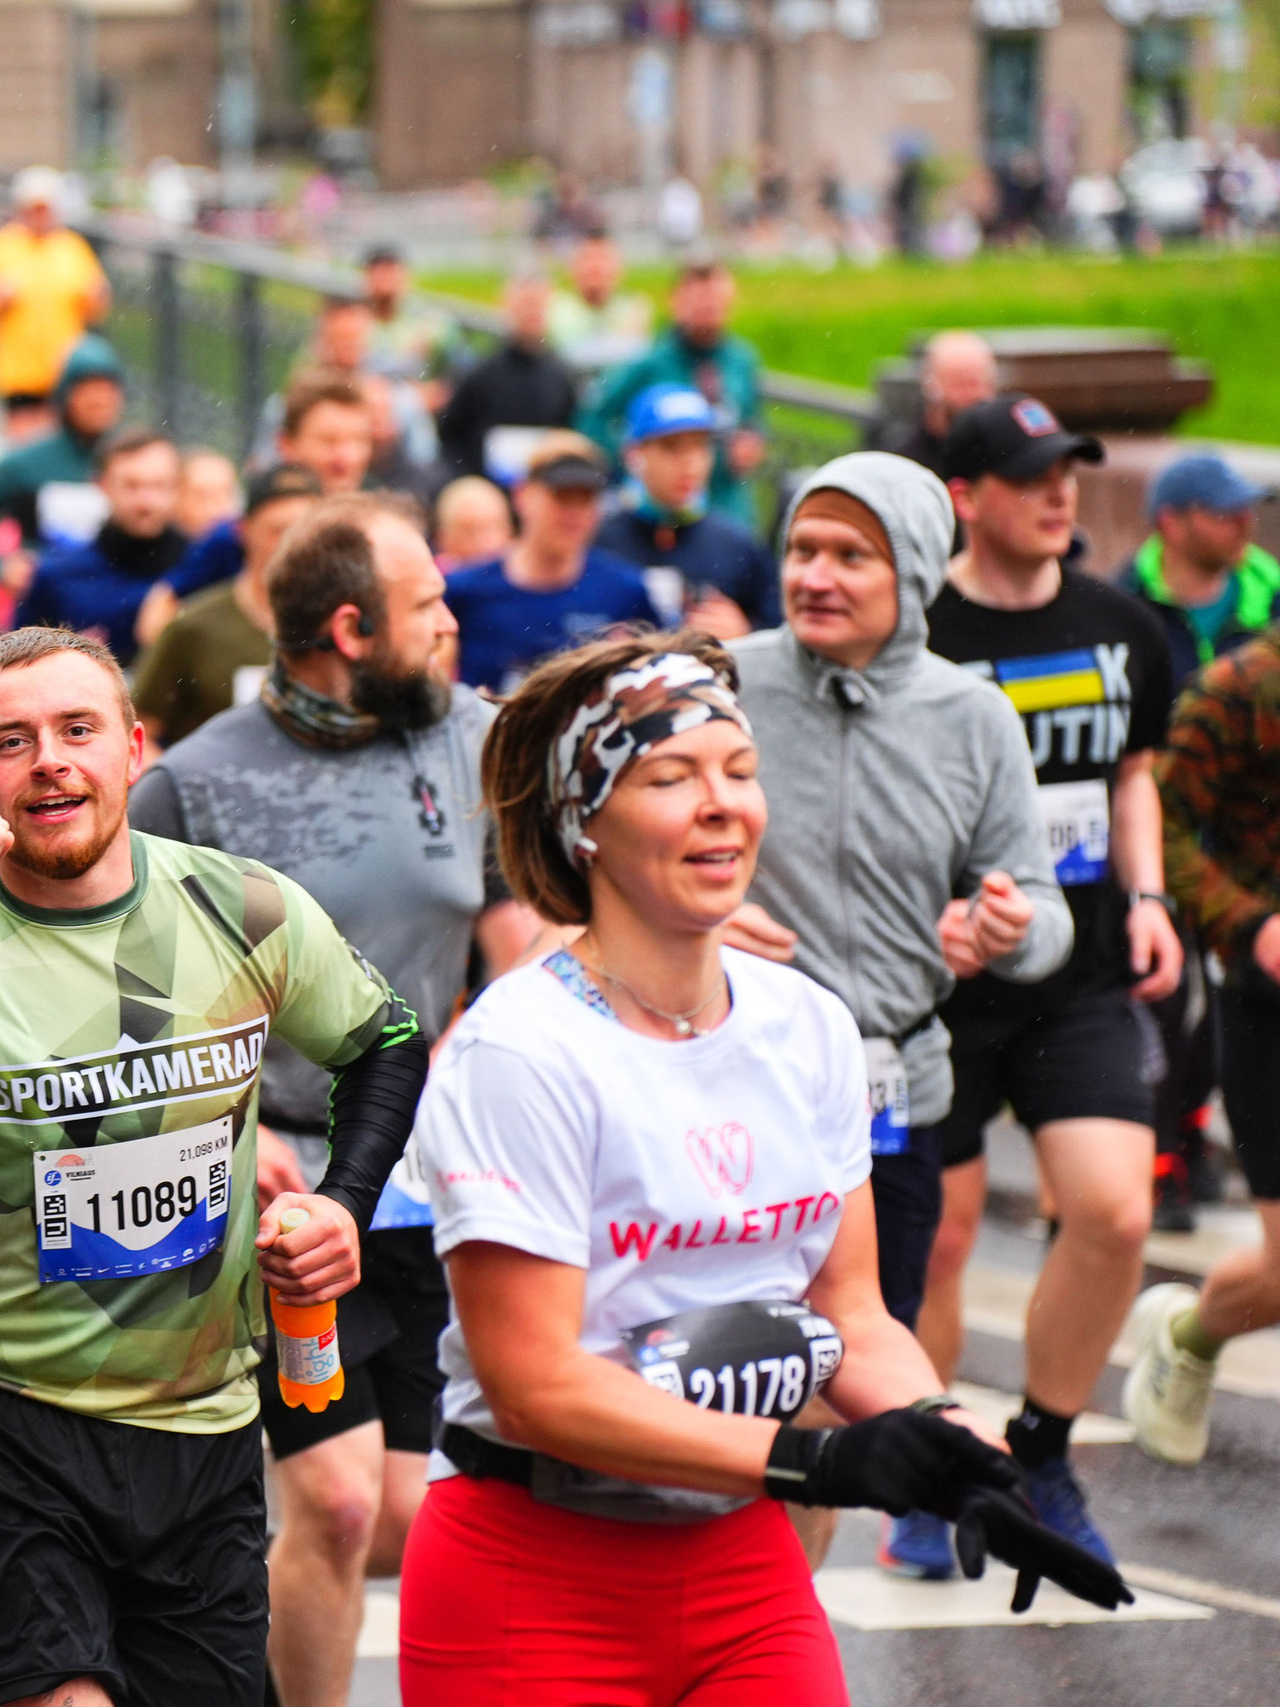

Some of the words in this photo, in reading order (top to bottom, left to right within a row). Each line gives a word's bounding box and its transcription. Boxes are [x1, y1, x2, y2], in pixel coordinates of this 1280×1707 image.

[215, 1135, 228, 1151] KM
[86, 1175, 198, 1234] 11089
[689, 1354, 807, 1417] 21178
